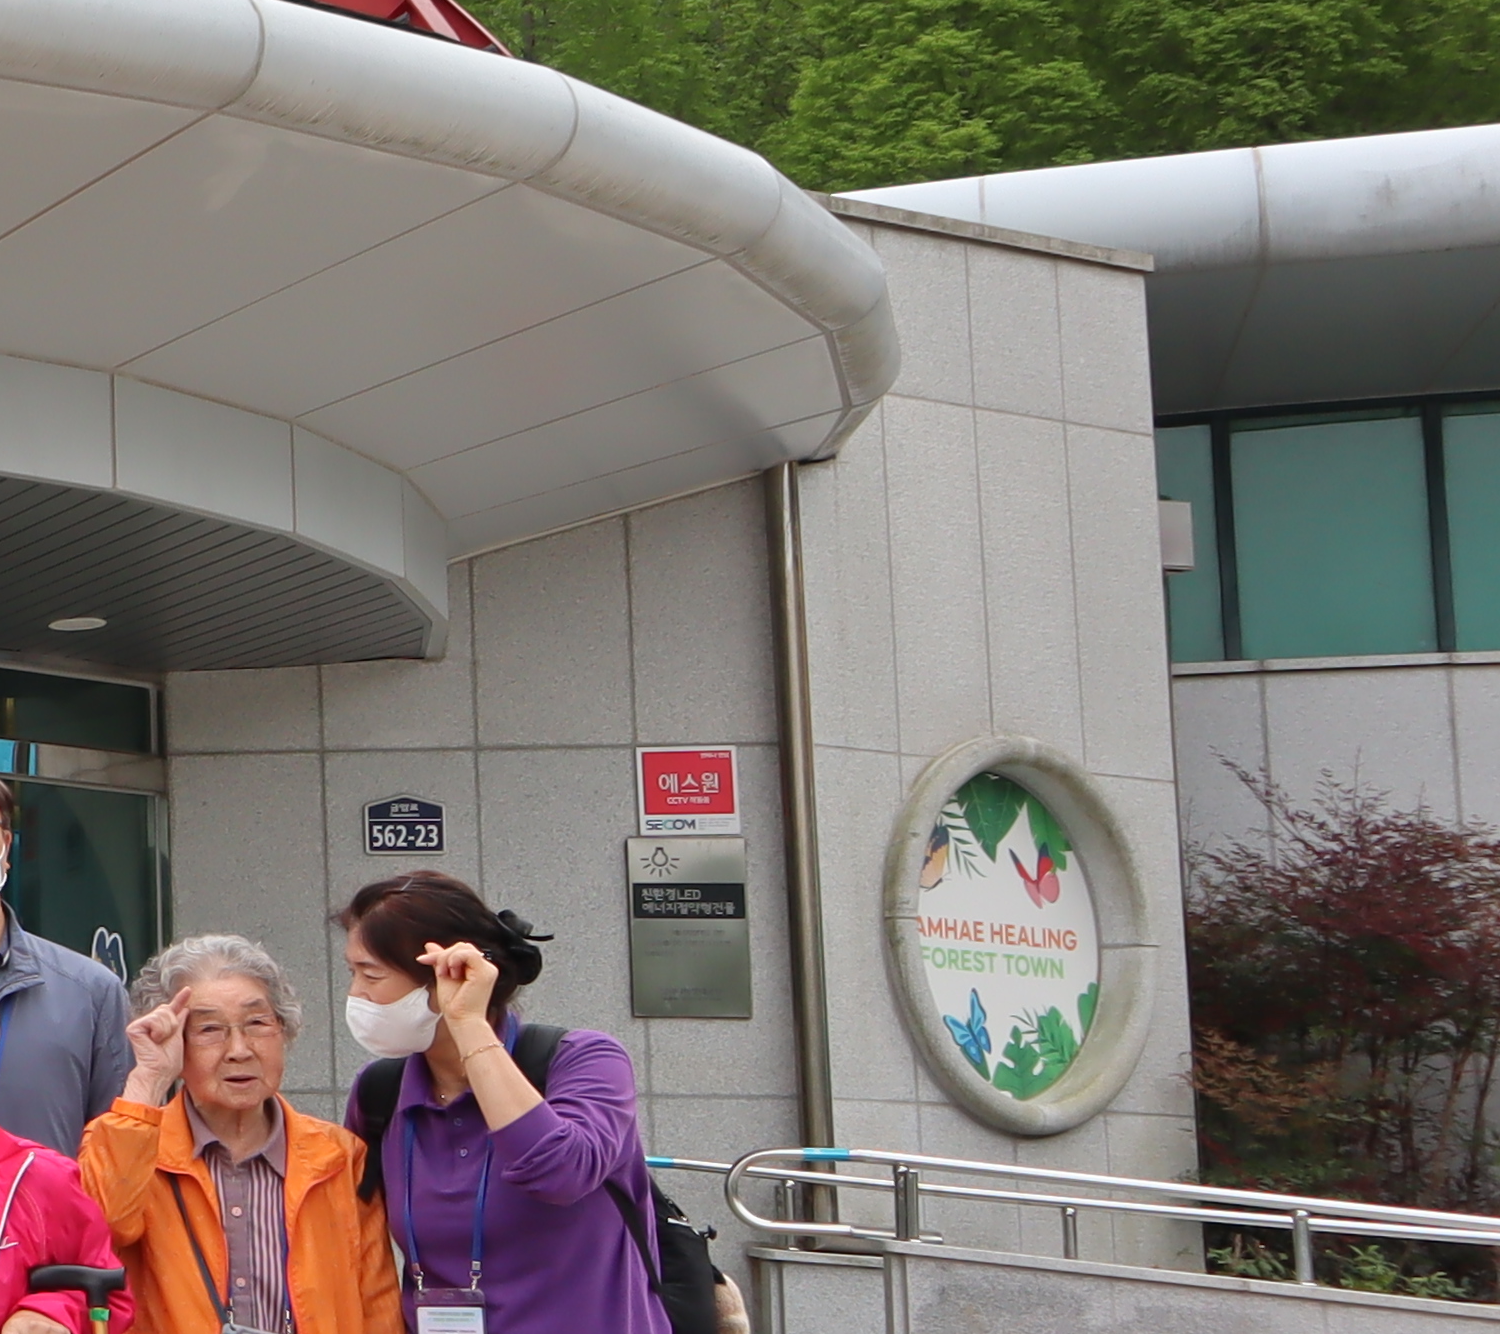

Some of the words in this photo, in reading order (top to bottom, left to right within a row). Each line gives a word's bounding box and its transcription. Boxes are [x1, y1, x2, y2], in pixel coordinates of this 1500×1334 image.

[658, 772, 719, 794] 에스원
[666, 796, 688, 804] CCTV
[646, 819, 696, 830] SECOM
[372, 825, 439, 847] 562-23
[916, 915, 985, 943] AMHAE
[990, 922, 1078, 952] HEALING
[920, 946, 998, 974] FOREST
[1002, 953, 1065, 980] TOWN
